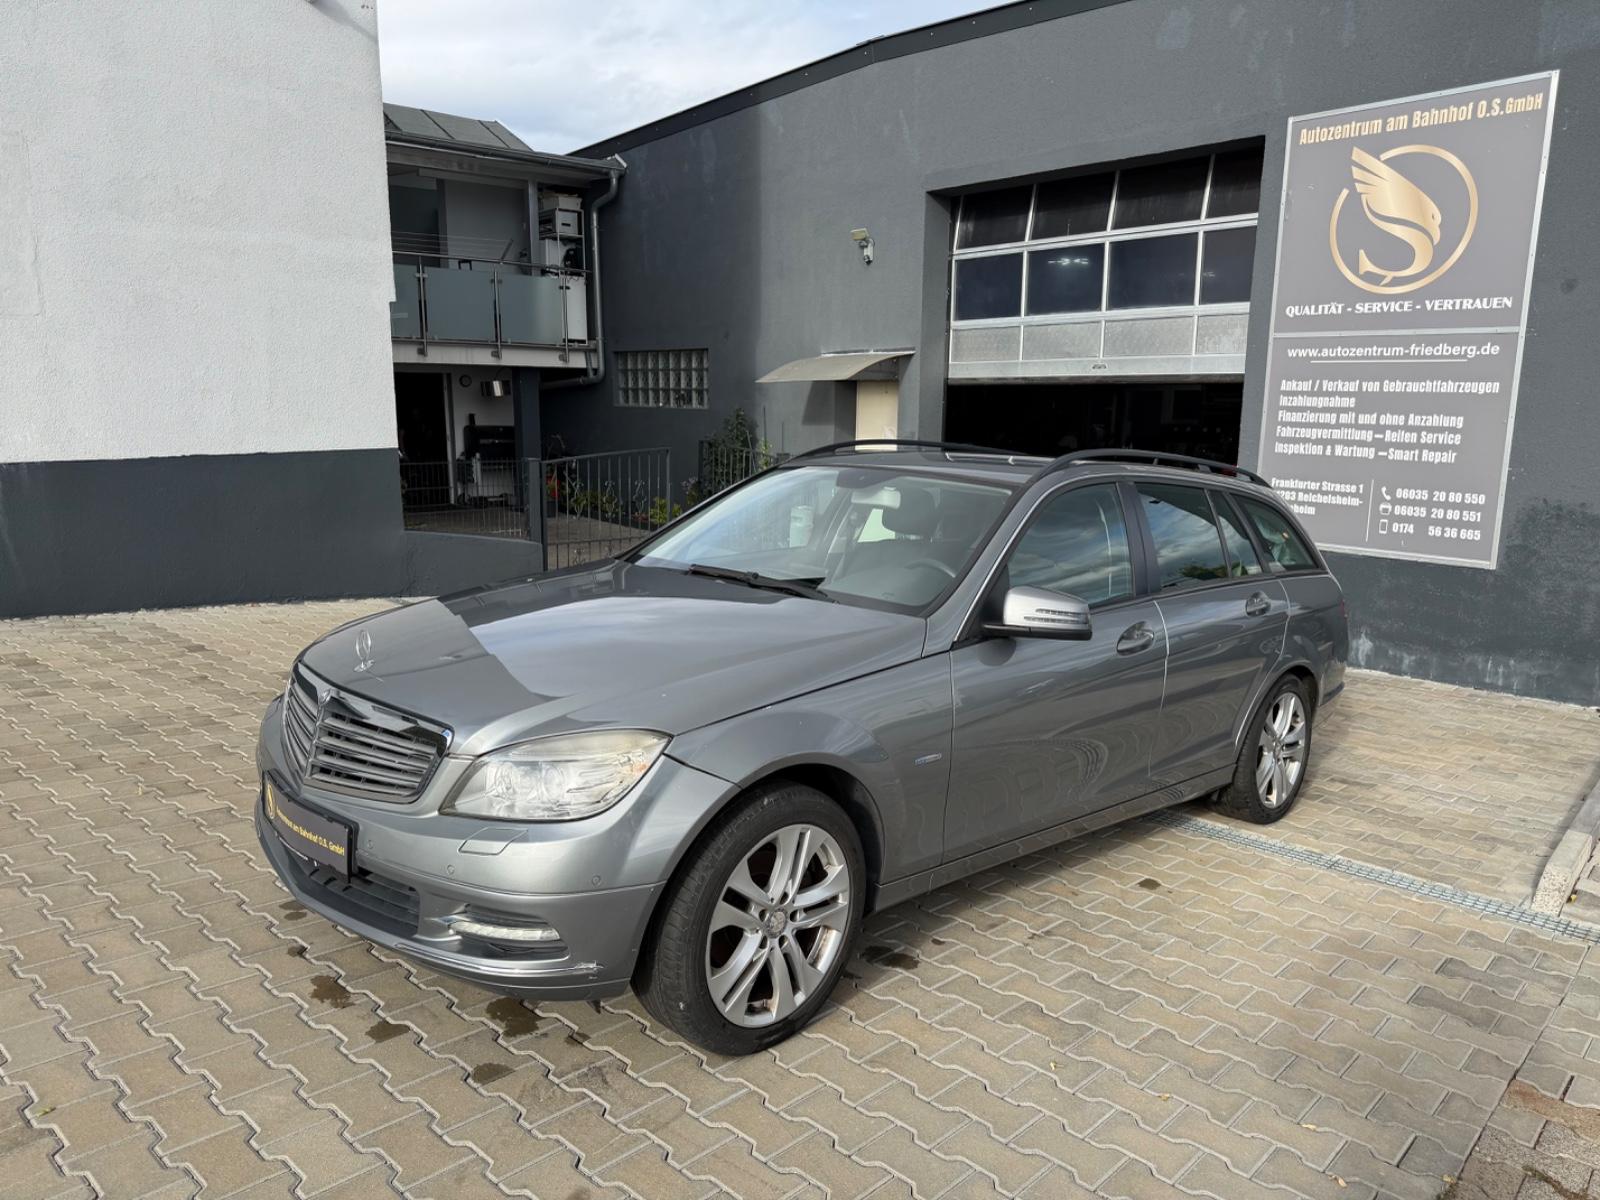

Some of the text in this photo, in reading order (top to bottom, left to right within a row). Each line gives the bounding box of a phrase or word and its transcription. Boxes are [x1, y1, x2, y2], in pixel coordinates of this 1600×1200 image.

[1299, 118, 1382, 145] Autozentrum
[1386, 113, 1408, 131] am
[1412, 102, 1474, 129] Bahnhof
[1285, 302, 1345, 318] QUALITÄT
[1355, 300, 1413, 314] SERVICE
[1425, 297, 1513, 311] VERTRAUEN
[1287, 342, 1500, 358] www.autozentrum-friedberg.de
[1280, 379, 1312, 392] Ankauf
[1322, 379, 1359, 392] Verkauf
[1362, 381, 1380, 392] von
[1383, 379, 1500, 395] Gebrauchtfahrzeugen
[1279, 394, 1356, 408] Inzahlungnahme
[1278, 410, 1464, 429] Finanzierung mit und ohne Anzahlung
[1276, 425, 1373, 442] Fahrzeugvermittlung
[1385, 429, 1418, 443] Reifen
[1420, 431, 1462, 445] Service
[1275, 441, 1323, 455] Inspektion
[1325, 444, 1331, 456] &
[1334, 444, 1376, 460] Wartung
[1422, 449, 1457, 464] Repair
[1271, 477, 1364, 494] Frankfurter Strasse 1
[1396, 488, 1486, 505] 06035 20 80 550
[1394, 505, 1481, 522] 06035 20 80 551
[1392, 522, 1414, 534] 0174
[1428, 525, 1442, 537] 56
[1443, 527, 1458, 539] 36
